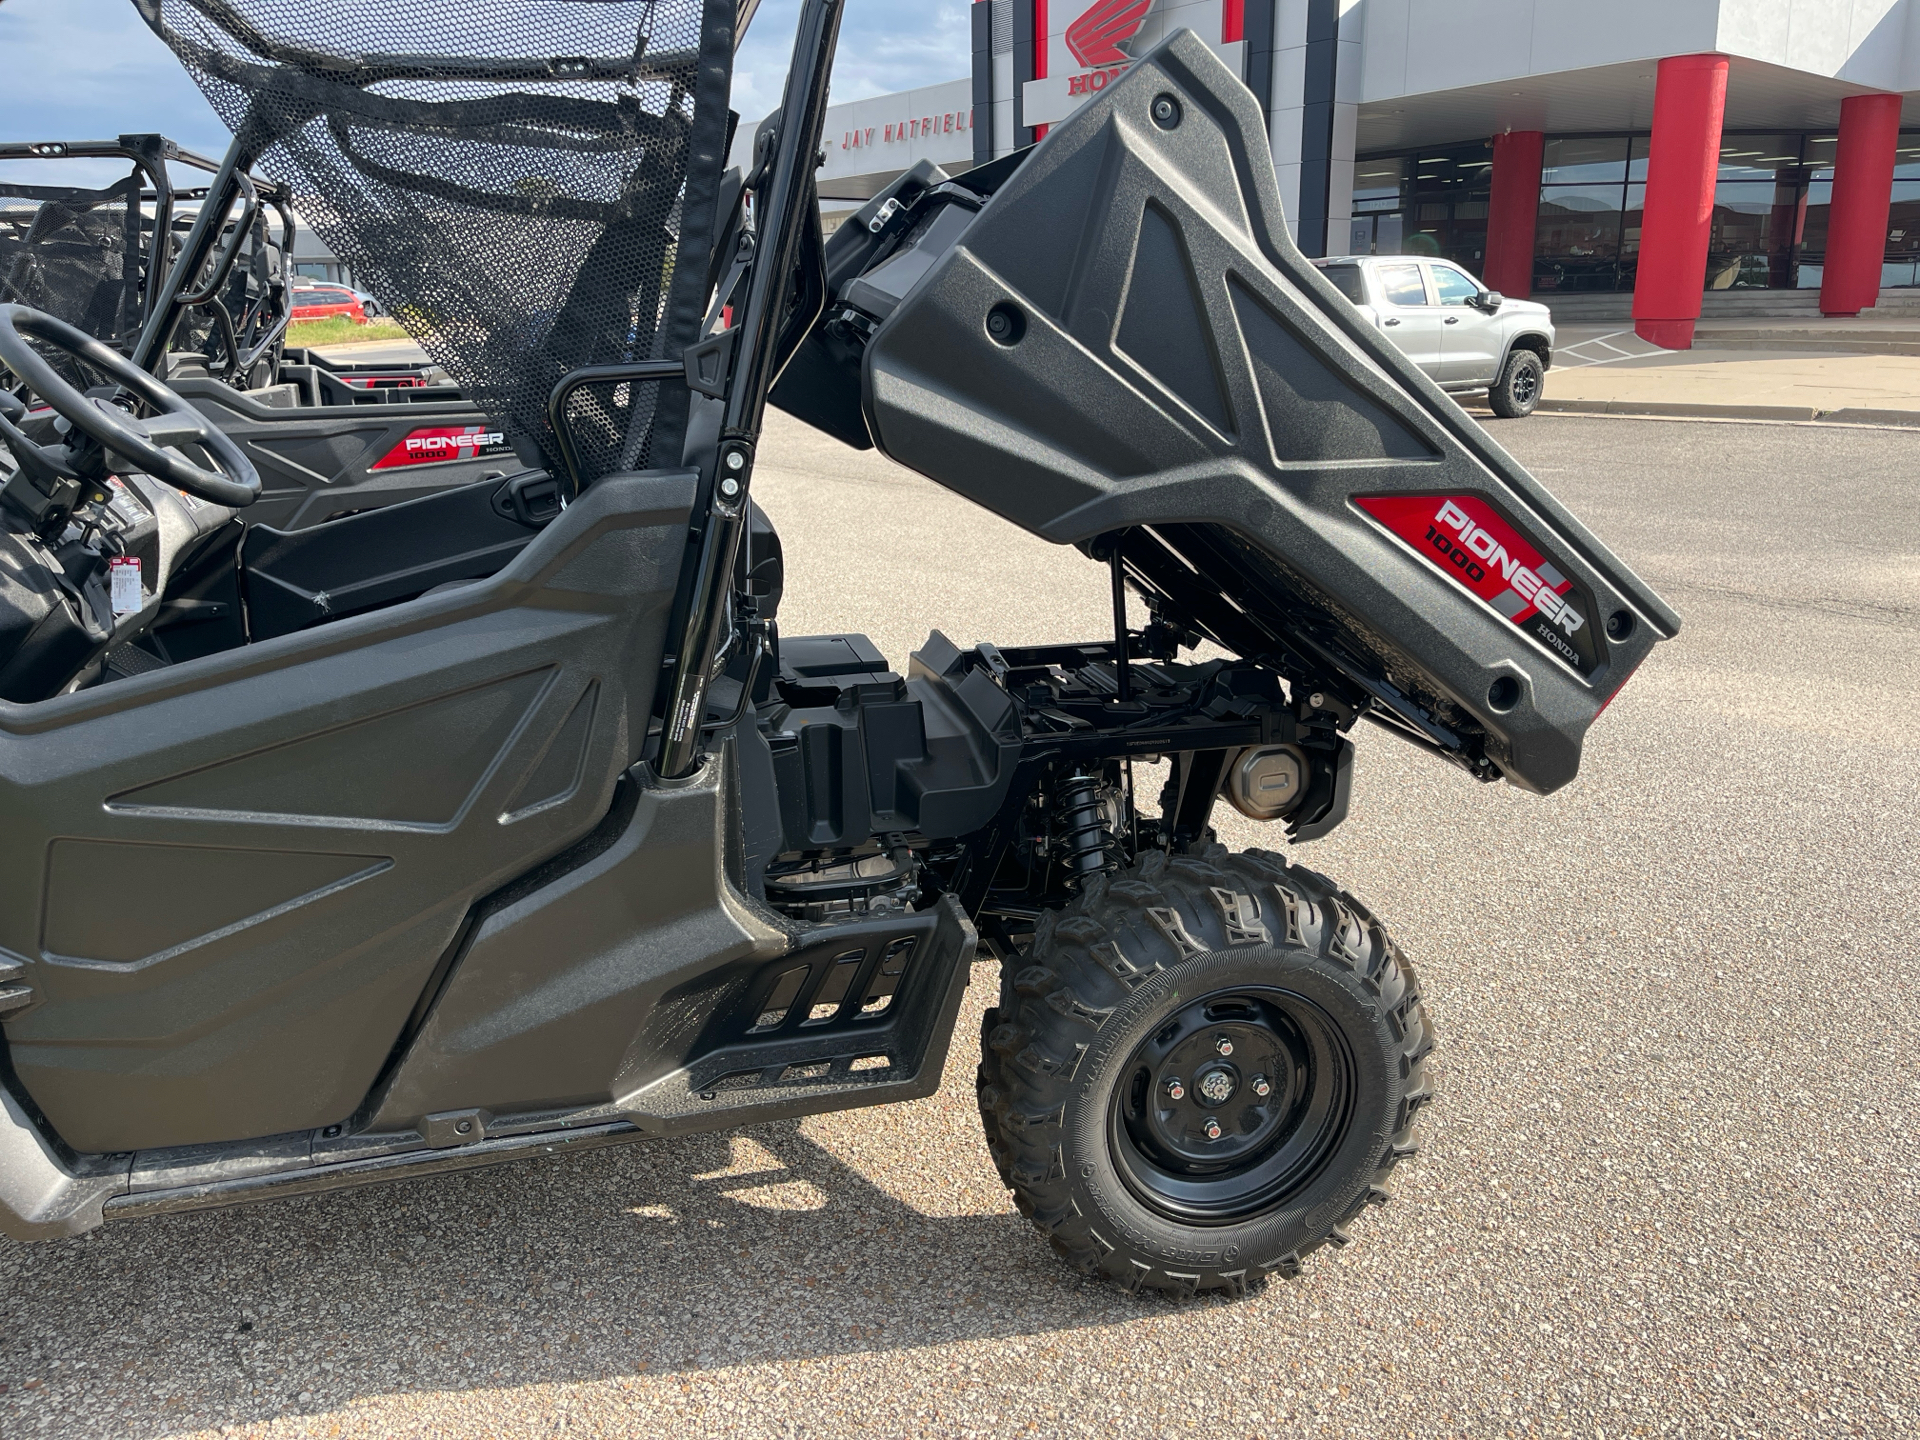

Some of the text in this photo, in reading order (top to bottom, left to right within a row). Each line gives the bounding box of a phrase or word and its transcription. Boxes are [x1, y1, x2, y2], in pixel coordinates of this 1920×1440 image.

[842, 109, 974, 150] JAY HATFIEL
[405, 433, 504, 450] PIONEER
[408, 451, 447, 460] 1000
[1424, 525, 1486, 583] 1000
[1434, 500, 1585, 637] PIONEER
[1536, 623, 1580, 666] HONDA
